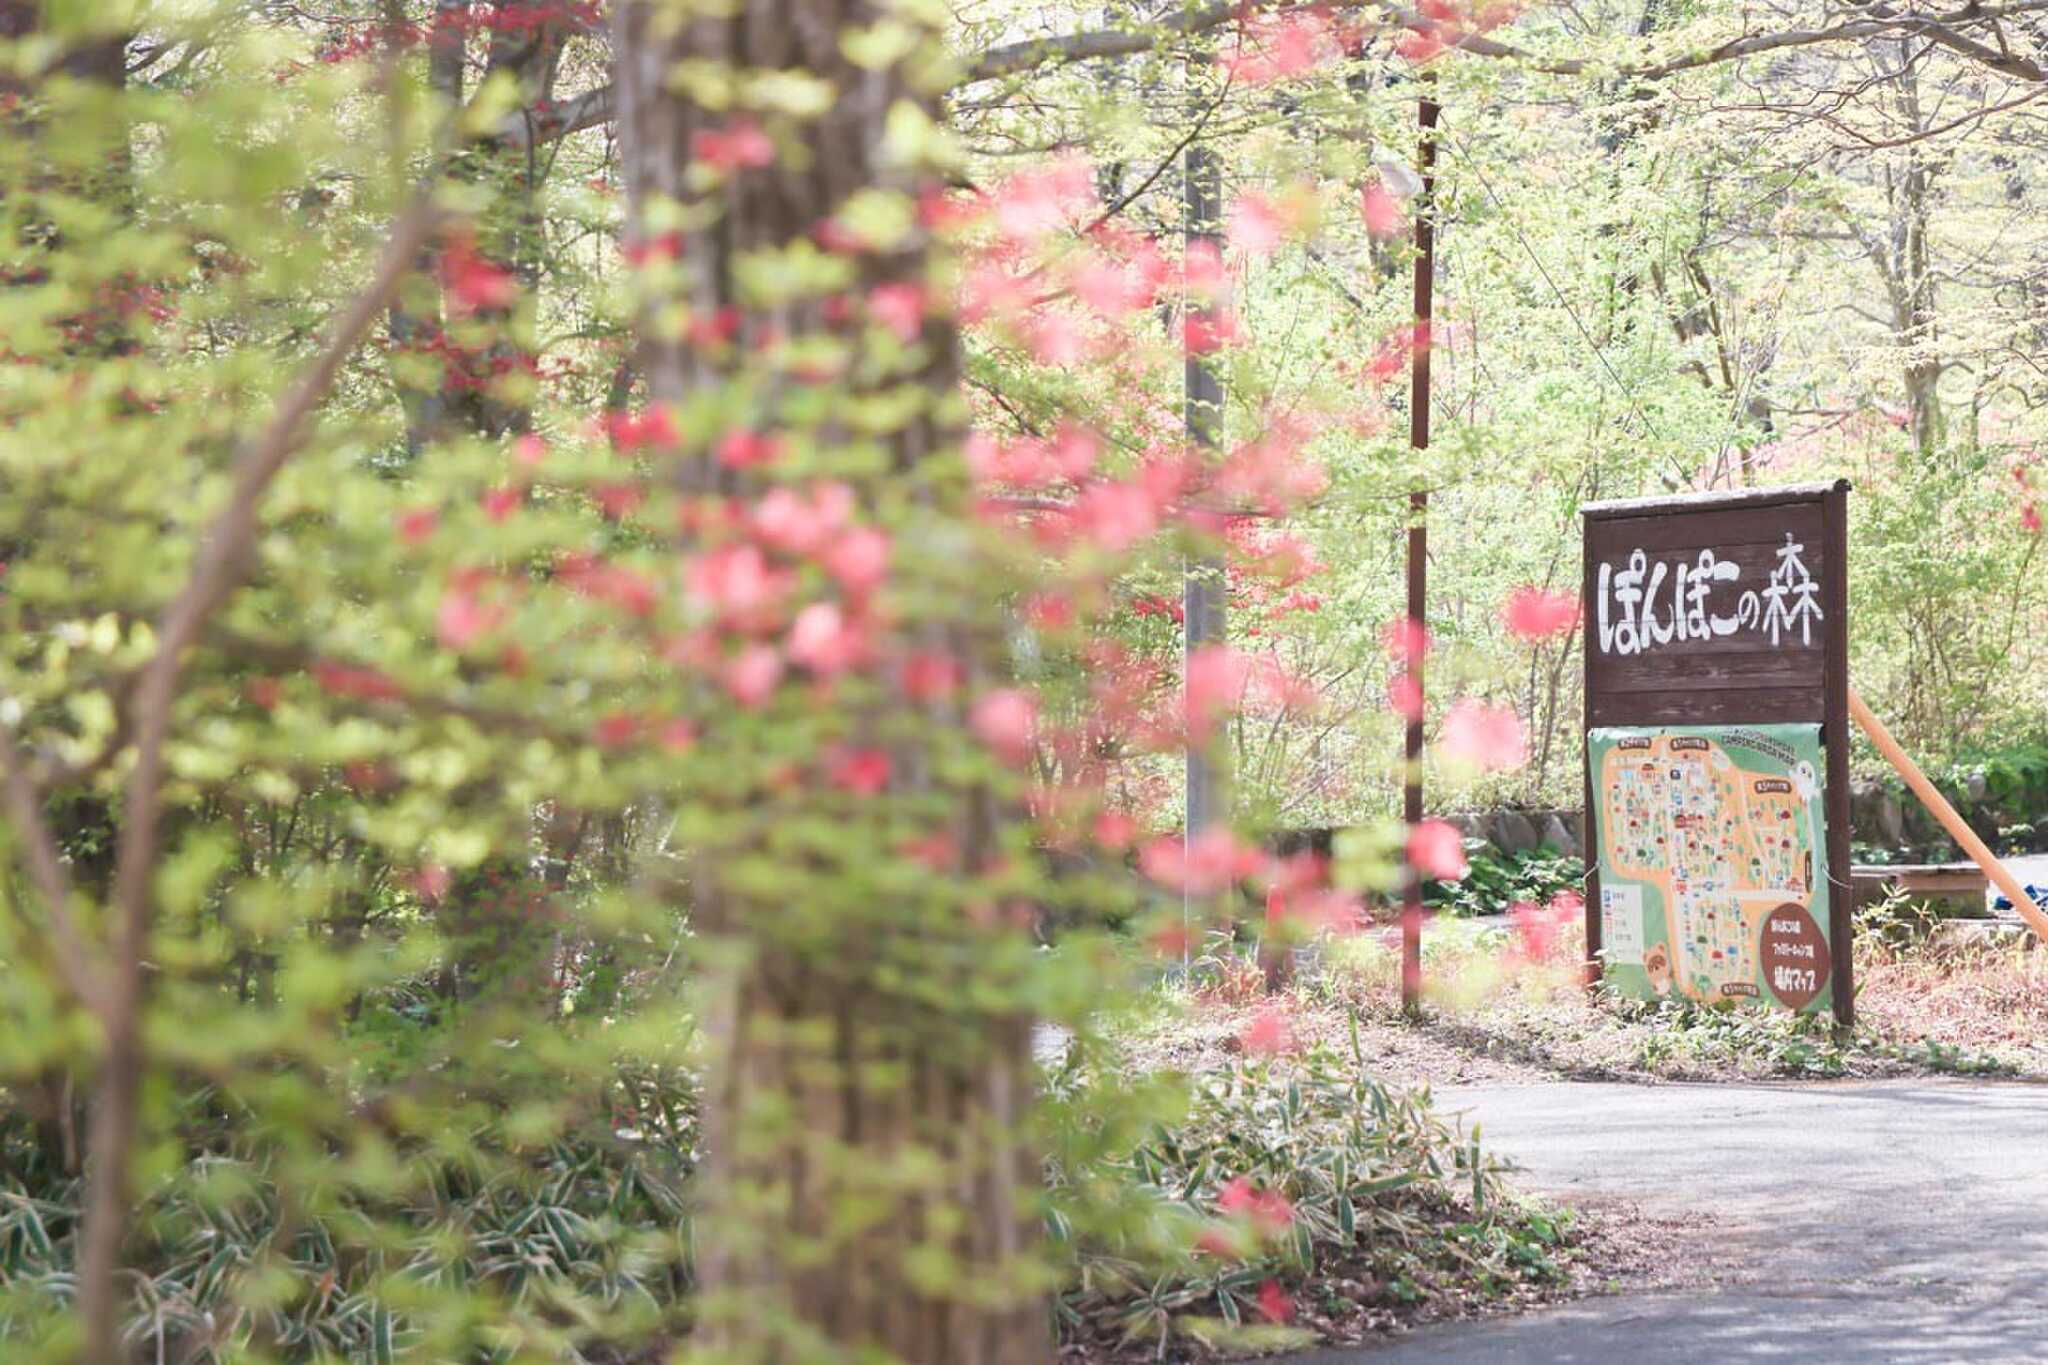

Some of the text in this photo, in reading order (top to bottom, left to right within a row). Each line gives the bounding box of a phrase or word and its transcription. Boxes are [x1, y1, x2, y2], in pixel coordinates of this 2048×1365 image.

[1598, 532, 1824, 655] ぽんぽこの森
